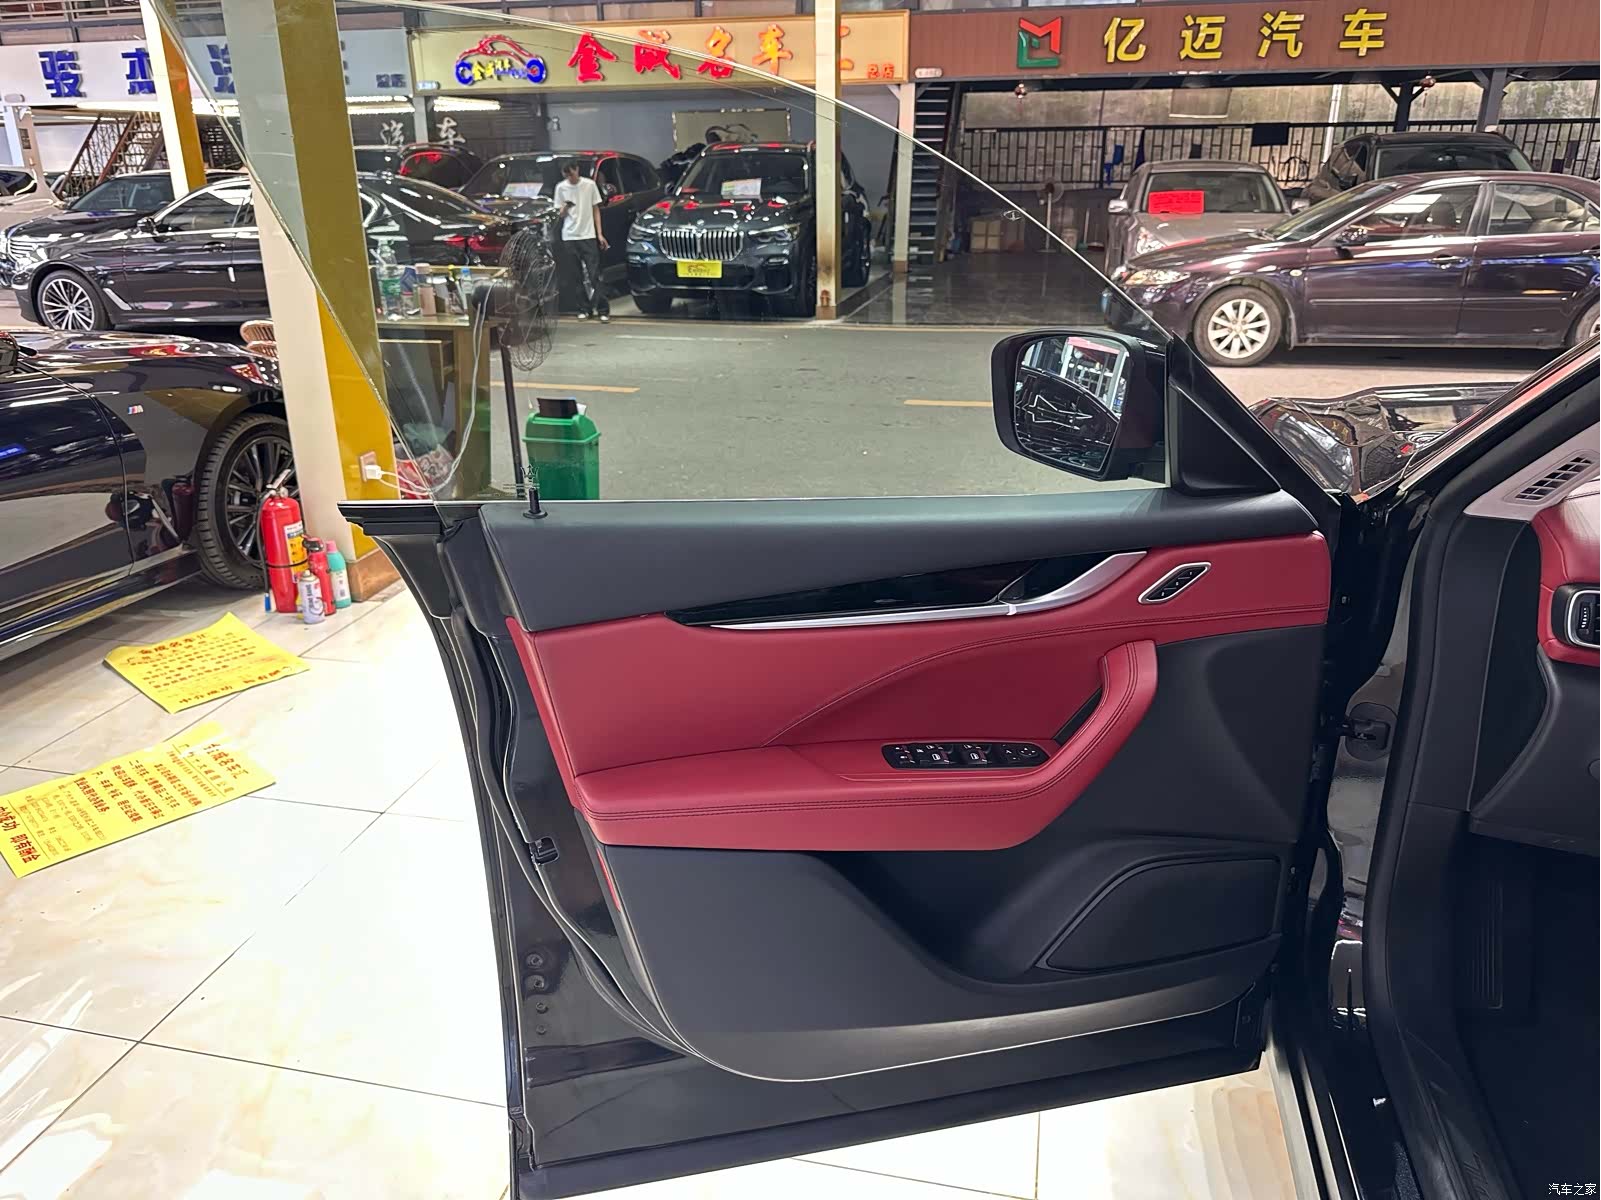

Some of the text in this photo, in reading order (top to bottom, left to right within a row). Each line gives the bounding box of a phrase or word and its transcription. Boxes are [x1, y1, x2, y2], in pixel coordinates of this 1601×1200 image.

[1103, 7, 1389, 64] 亿迈汽车
[10, 833, 41, 864] 即有酬金
